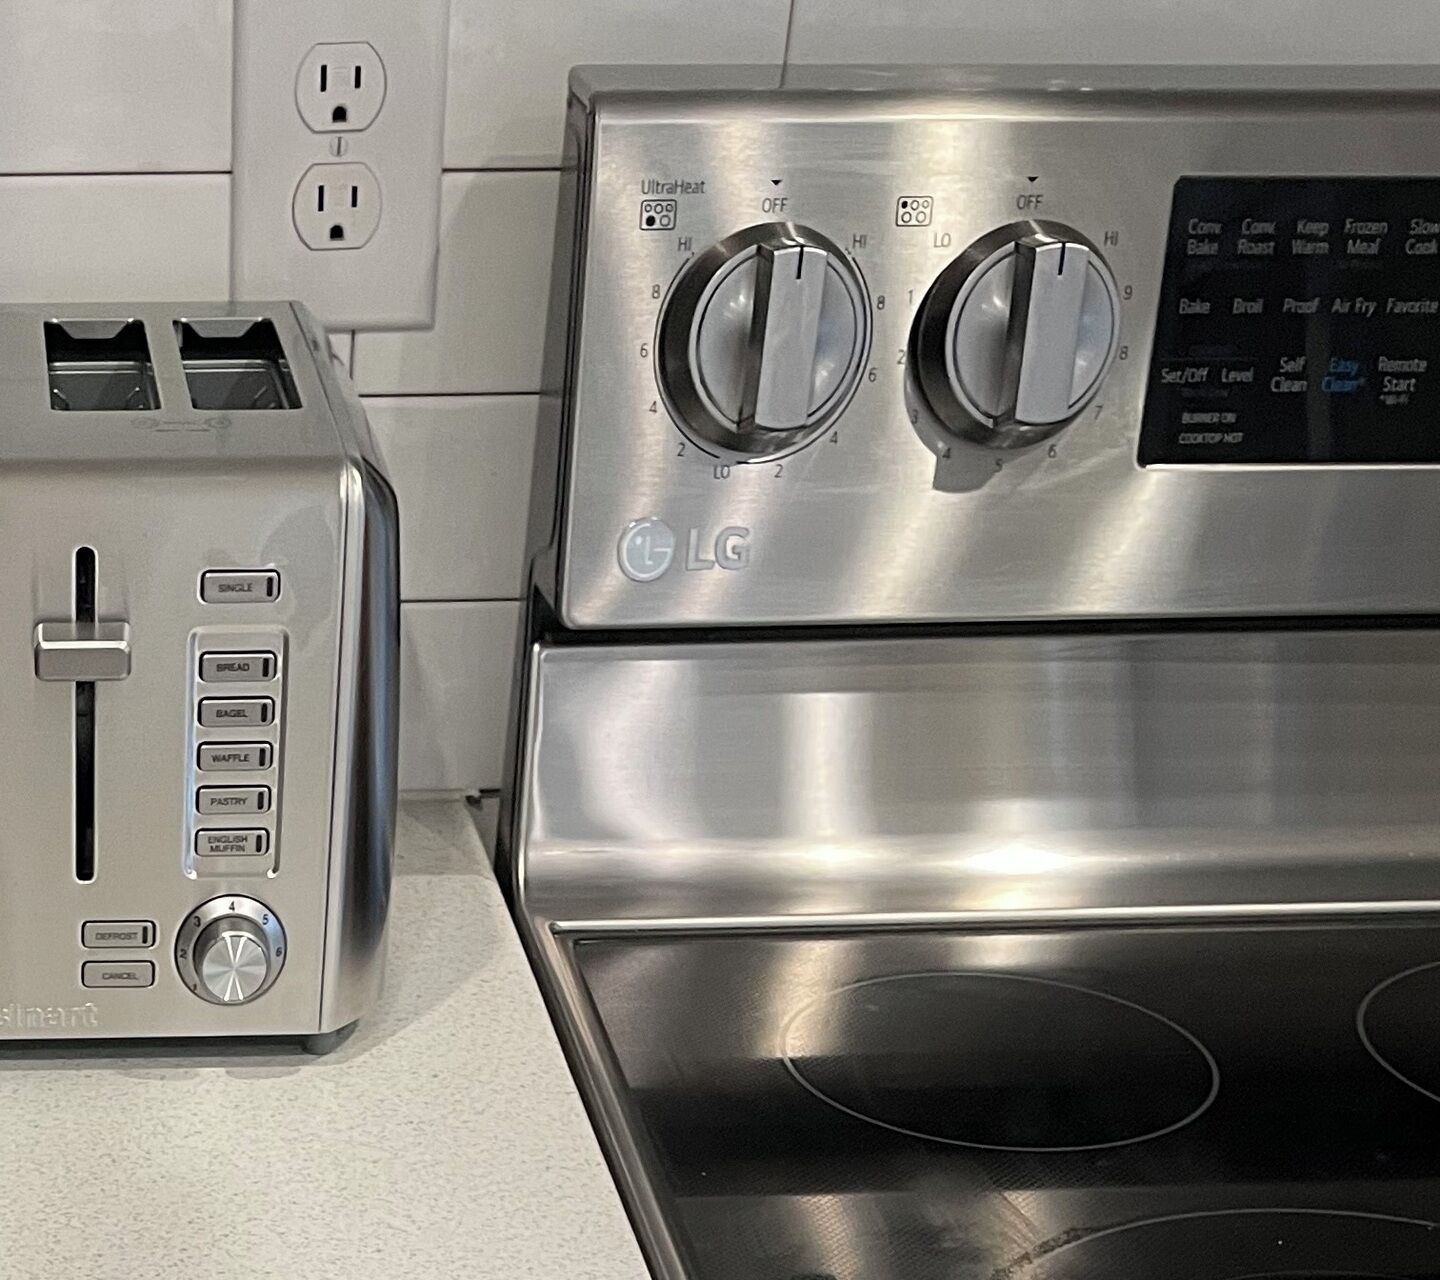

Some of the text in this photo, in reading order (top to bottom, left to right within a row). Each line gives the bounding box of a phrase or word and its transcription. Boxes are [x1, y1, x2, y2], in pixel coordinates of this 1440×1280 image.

[640, 179, 706, 195] UltraHeat
[761, 197, 789, 213] OFF
[1016, 194, 1044, 210] OFF
[1296, 219, 1330, 237] Keep
[1343, 218, 1388, 235] Frozen
[678, 237, 692, 251] HI
[852, 234, 867, 249] HI
[933, 232, 952, 248] LO
[1103, 231, 1119, 246] HI
[1186, 238, 1219, 255] Bake
[1236, 238, 1276, 255] Roast
[1346, 237, 1382, 255] Meal
[1404, 238, 1439, 255] Cook
[1291, 239, 1330, 255] Warm
[1178, 298, 1211, 314] Bake
[1232, 297, 1264, 314] Broil
[1282, 297, 1321, 314] Proof
[1331, 297, 1378, 317] Air Fry
[1279, 356, 1307, 373] Self
[1328, 357, 1360, 375] Easy
[1377, 356, 1428, 373] Remote
[1161, 366, 1210, 384] Set/Off
[1221, 366, 1255, 383] Level
[1270, 377, 1308, 392] Clean
[1382, 377, 1417, 392] Start
[713, 463, 731, 480] LO
[685, 526, 750, 571] LG
[218, 582, 253, 593] SINGLE
[216, 662, 250, 672] BREAD
[216, 709, 248, 718] BAGEL
[211, 753, 250, 763] WAFFLE
[210, 797, 248, 806] PASTRY
[208, 835, 248, 844] ENGLISH
[210, 844, 246, 853] MUFFIN
[95, 931, 138, 941] DEFROST
[102, 971, 139, 981] CANCEL
